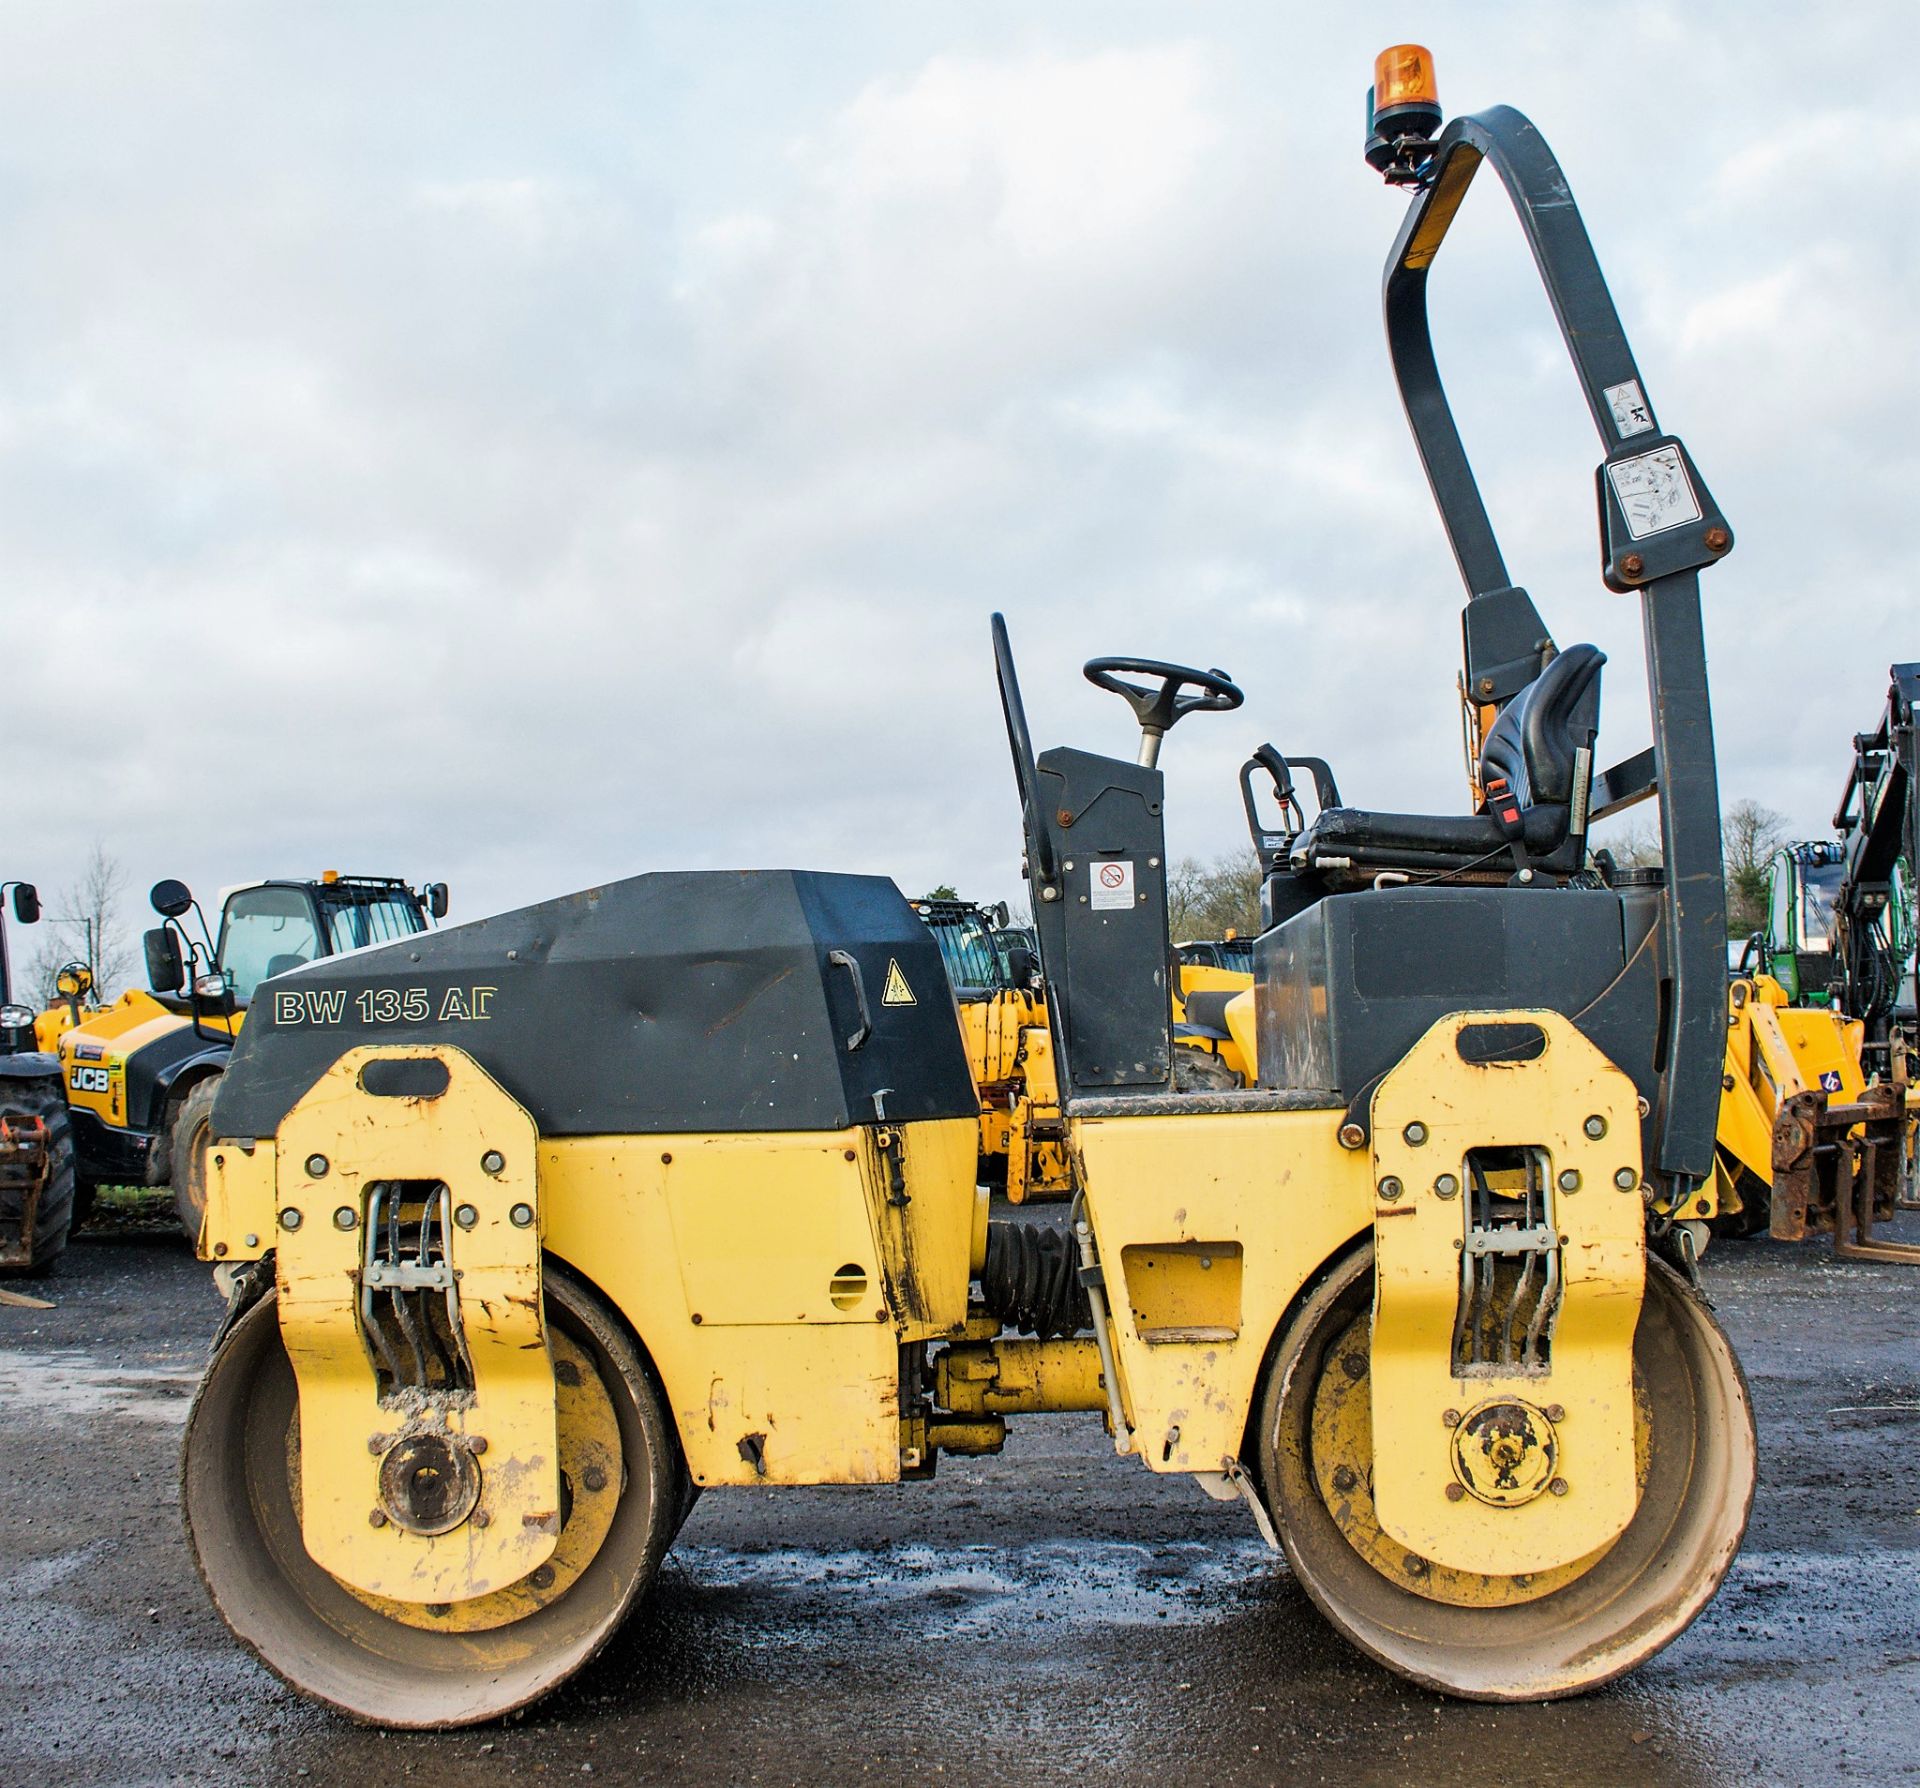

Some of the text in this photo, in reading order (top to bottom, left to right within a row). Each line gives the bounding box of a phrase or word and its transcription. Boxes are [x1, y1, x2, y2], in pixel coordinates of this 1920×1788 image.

[275, 990, 347, 1025] BW
[355, 988, 430, 1023] 135
[71, 1067, 109, 1092] JCB
